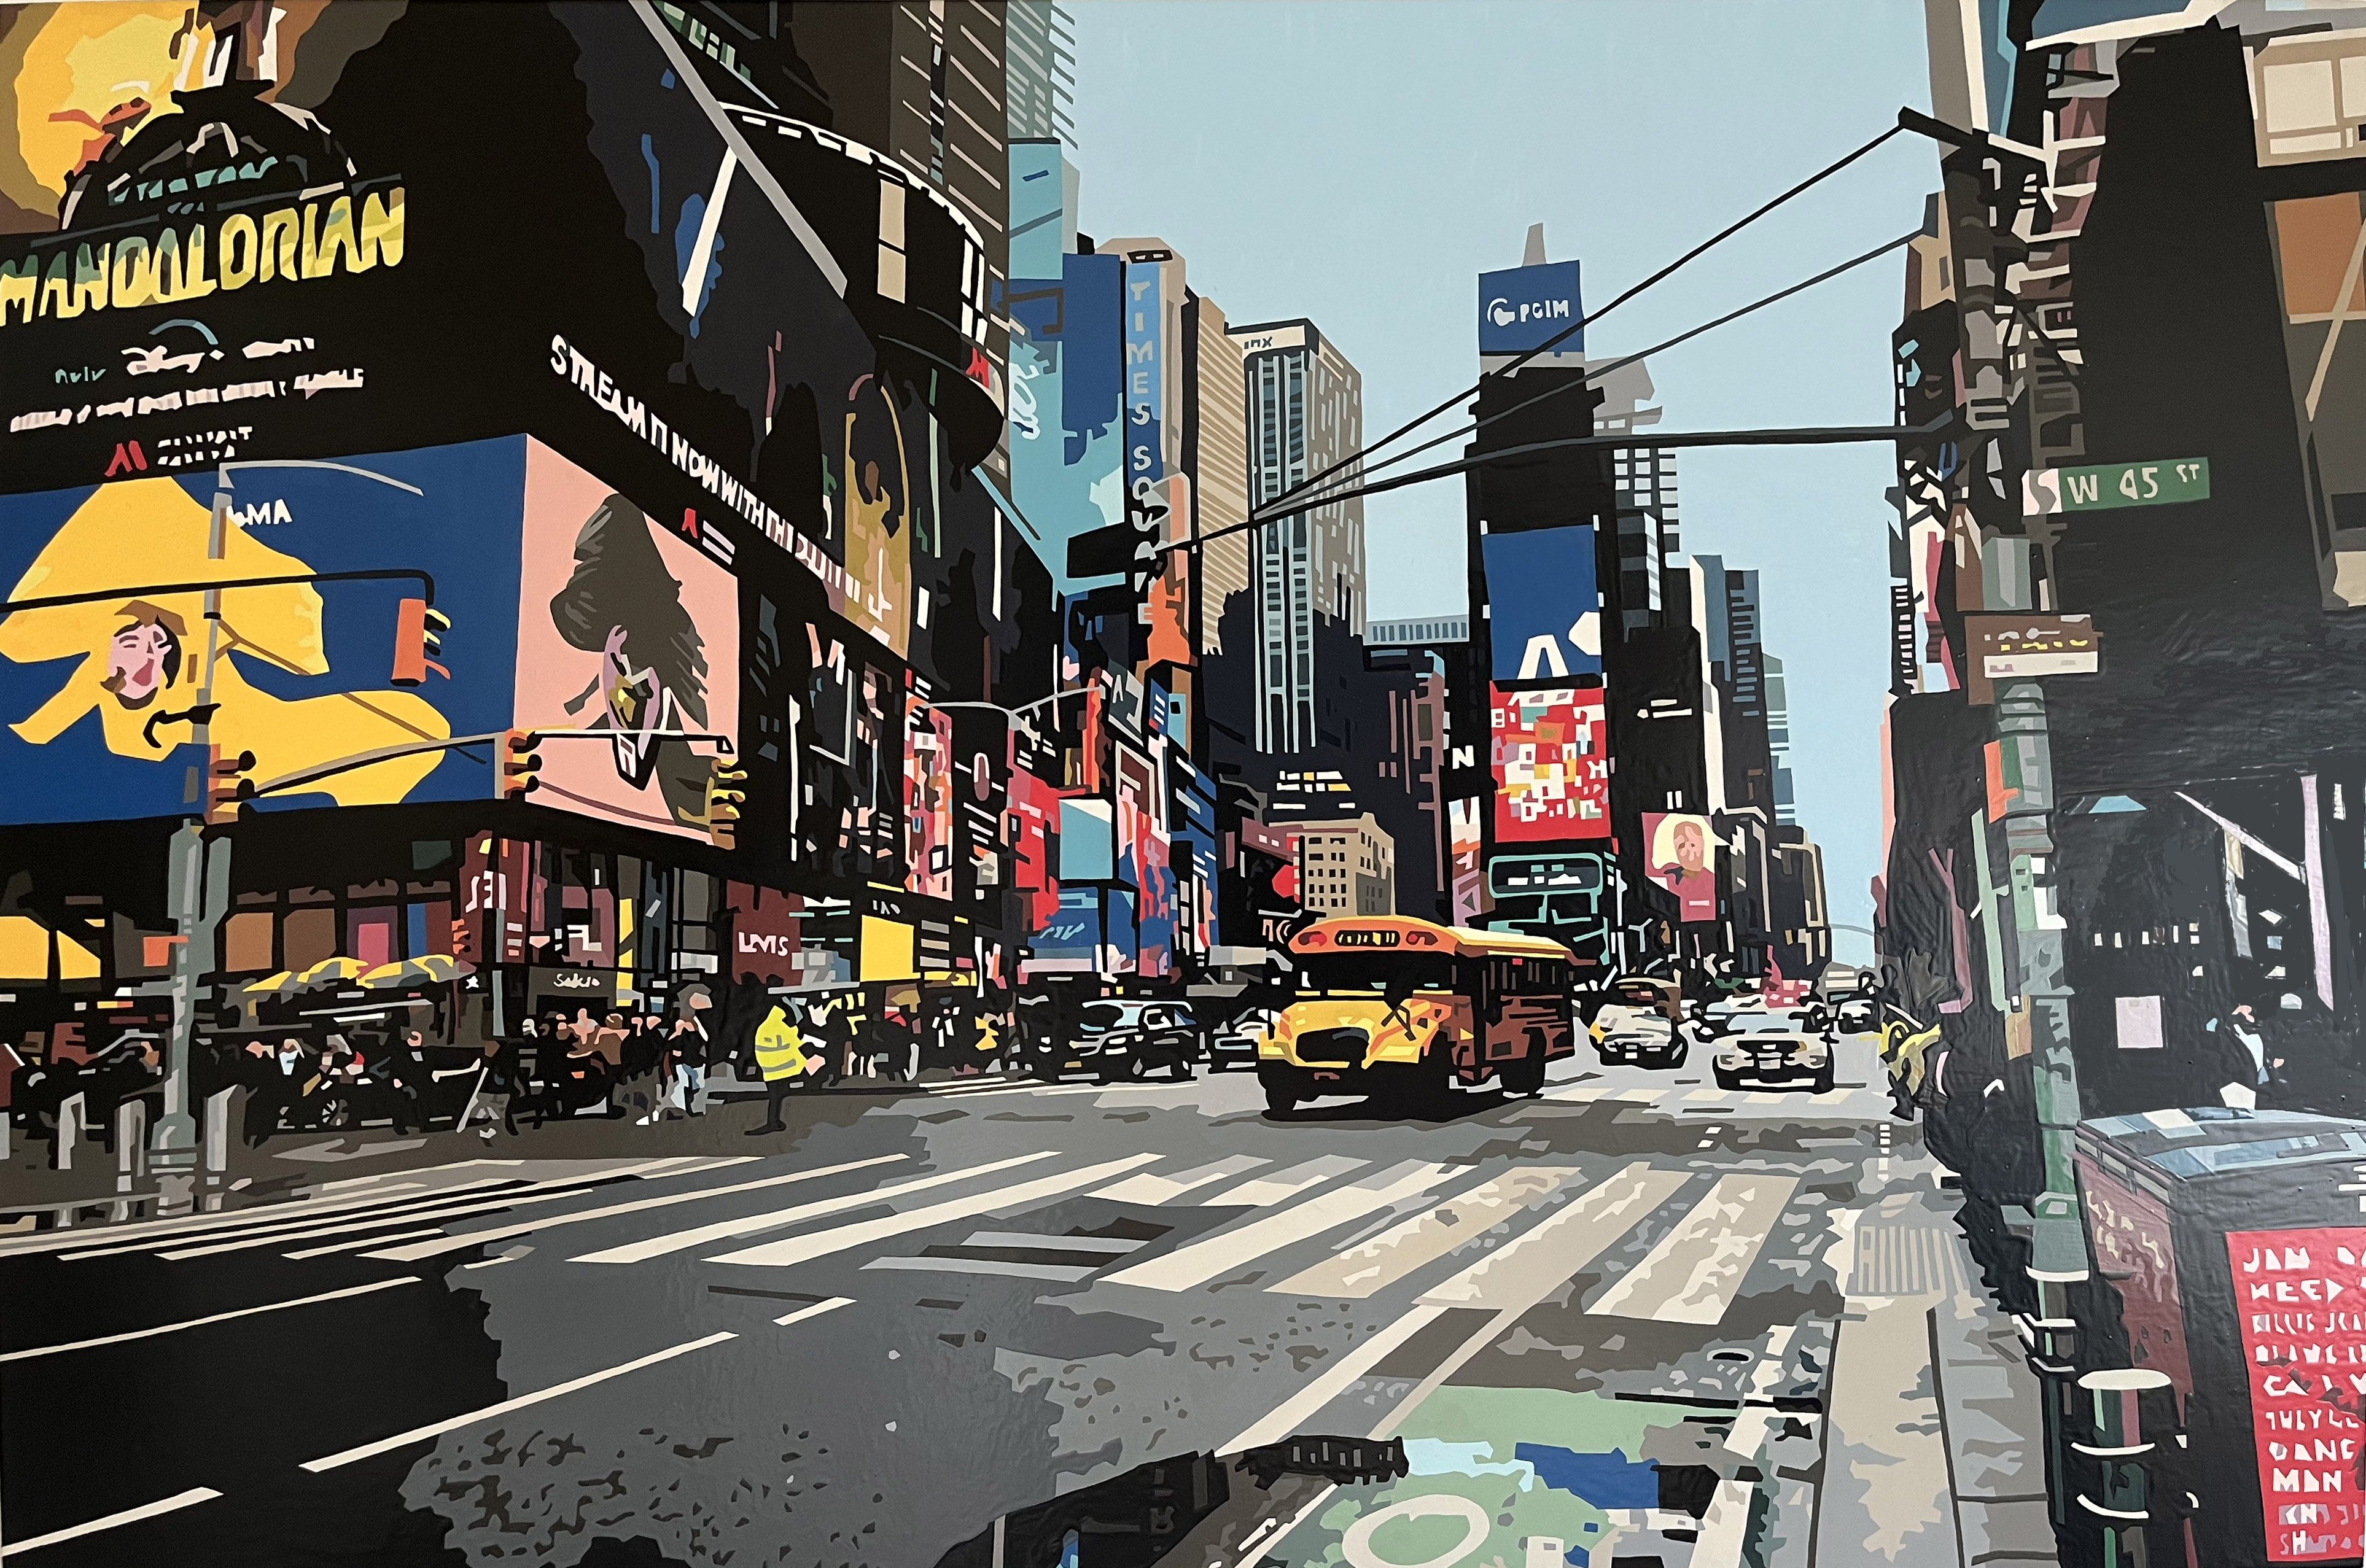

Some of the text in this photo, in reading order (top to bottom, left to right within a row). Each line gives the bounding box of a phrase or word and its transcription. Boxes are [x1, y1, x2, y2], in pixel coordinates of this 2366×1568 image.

[1127, 281, 1153, 425] TIMES
[672, 432, 720, 494] NOW
[722, 470, 766, 531] WITH
[2067, 474, 2098, 504] W
[2176, 464, 2200, 483] ST
